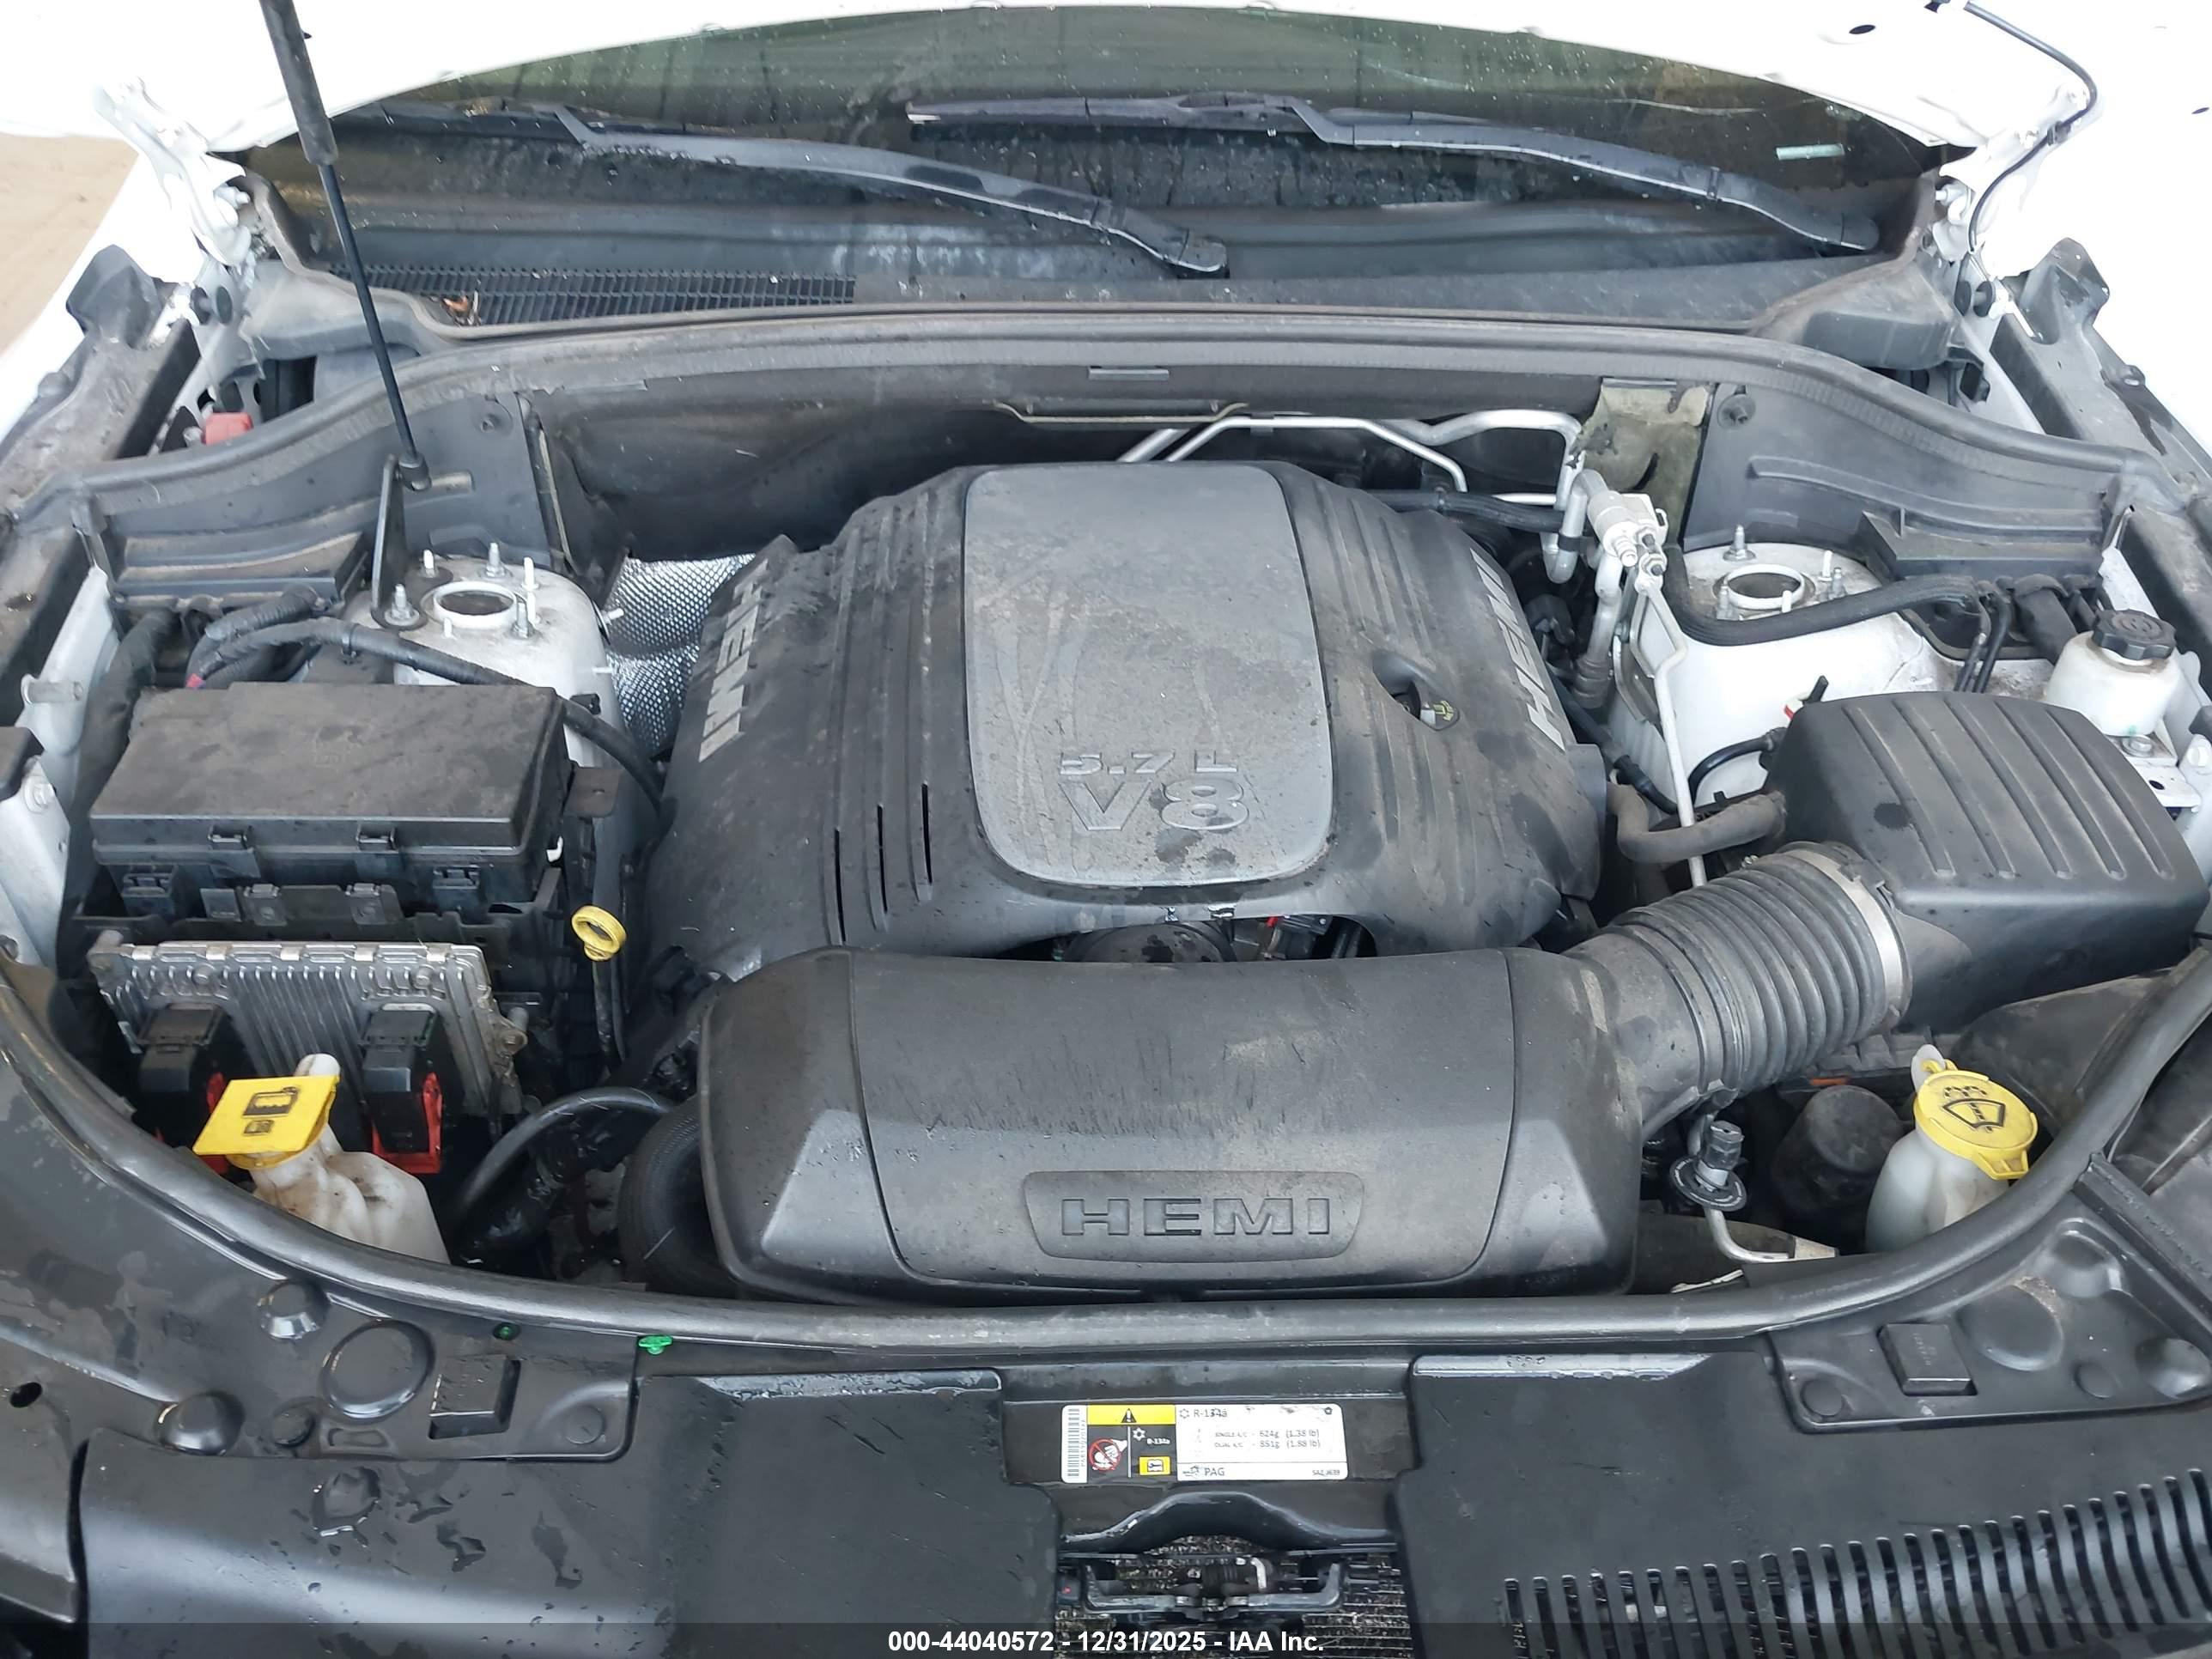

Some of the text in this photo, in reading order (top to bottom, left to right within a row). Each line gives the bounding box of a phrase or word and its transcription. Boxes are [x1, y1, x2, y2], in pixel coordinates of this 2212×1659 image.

[698, 558, 769, 763] HEMI
[1469, 548, 1566, 753] HEMI
[1057, 778, 1249, 830] V8
[1061, 1198, 1330, 1237] HEMI
[1205, 1468, 1224, 1477] PAG
